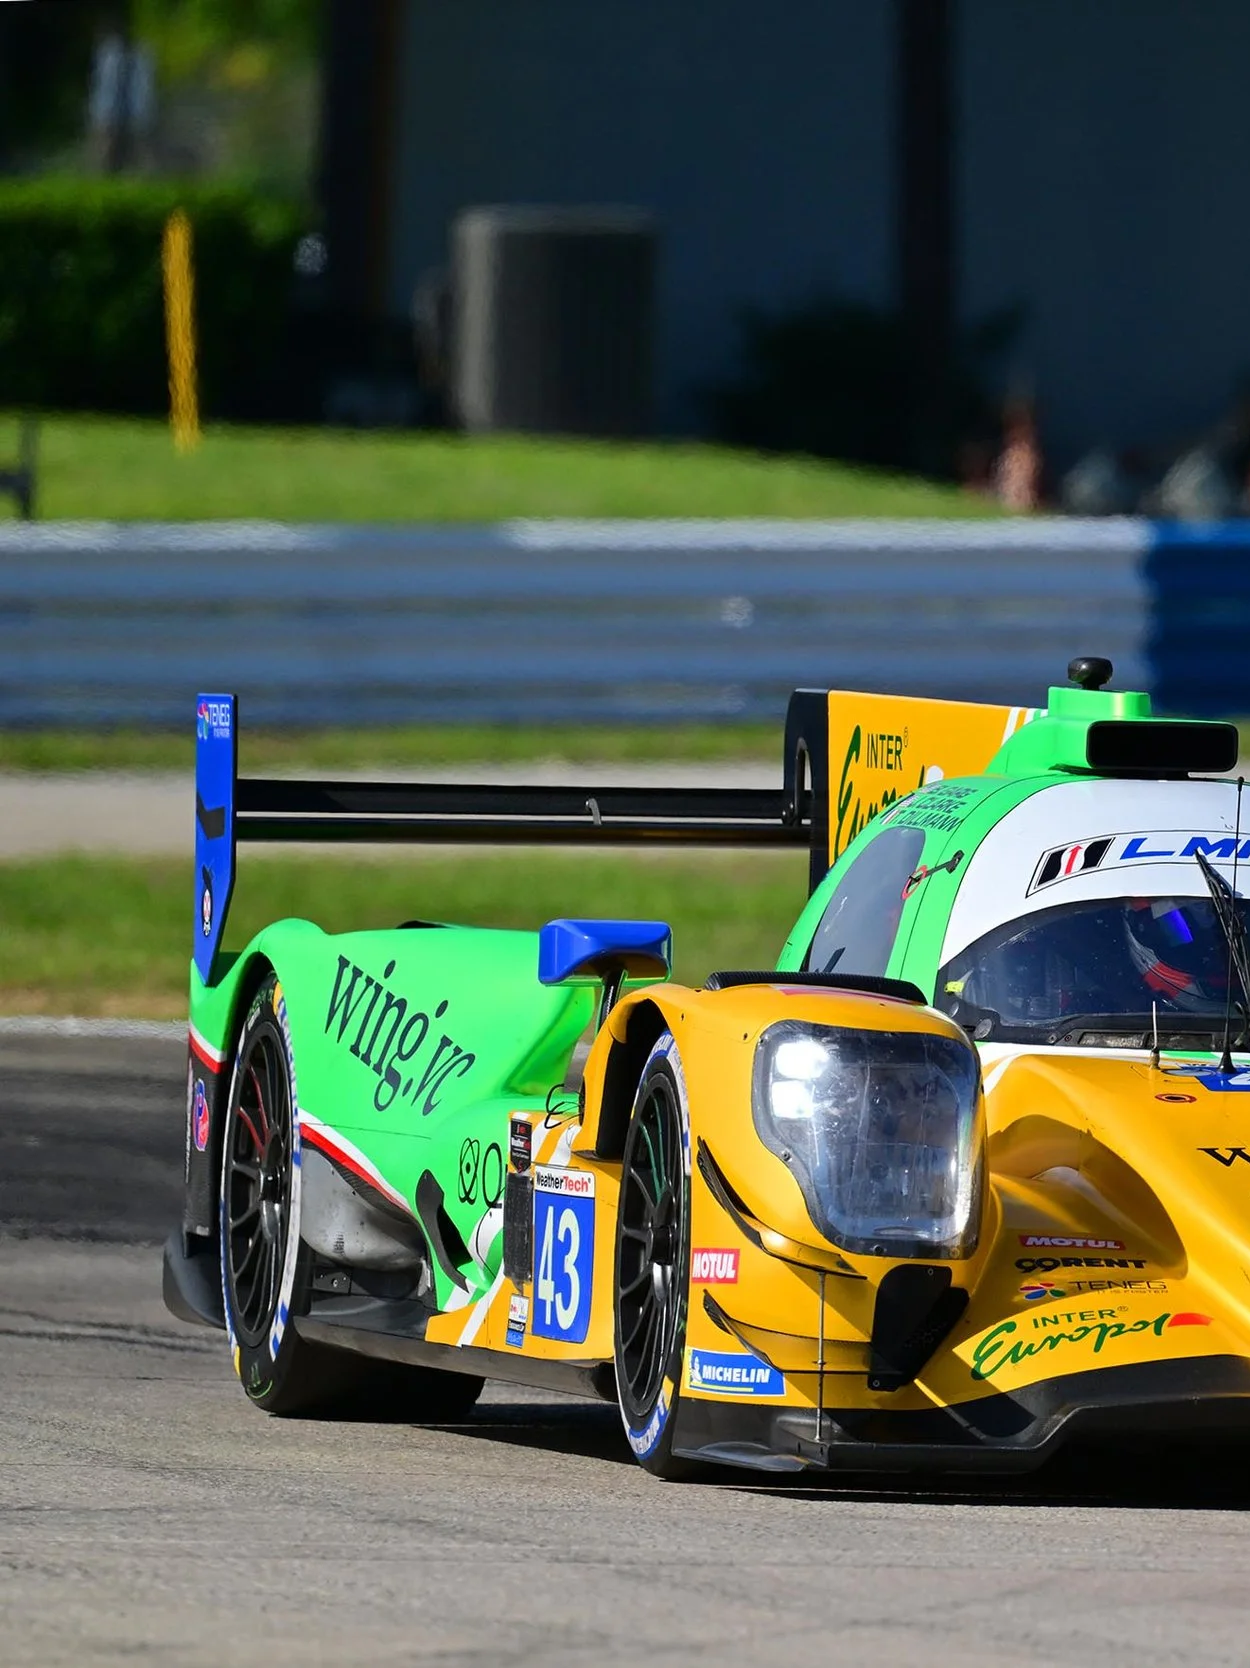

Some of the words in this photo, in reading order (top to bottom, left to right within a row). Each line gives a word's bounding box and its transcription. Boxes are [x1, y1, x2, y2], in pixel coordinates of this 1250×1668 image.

[325, 954, 476, 1117] wing.vc
[1024, 1235, 1121, 1250] MOTUL
[537, 1206, 580, 1330] 43
[692, 1252, 736, 1279] MOTUL
[1014, 1257, 1149, 1275] 99RENT
[1067, 1279, 1168, 1291] TENEG
[970, 1312, 1171, 1381] Europol
[702, 1364, 771, 1384] MICHELIN
